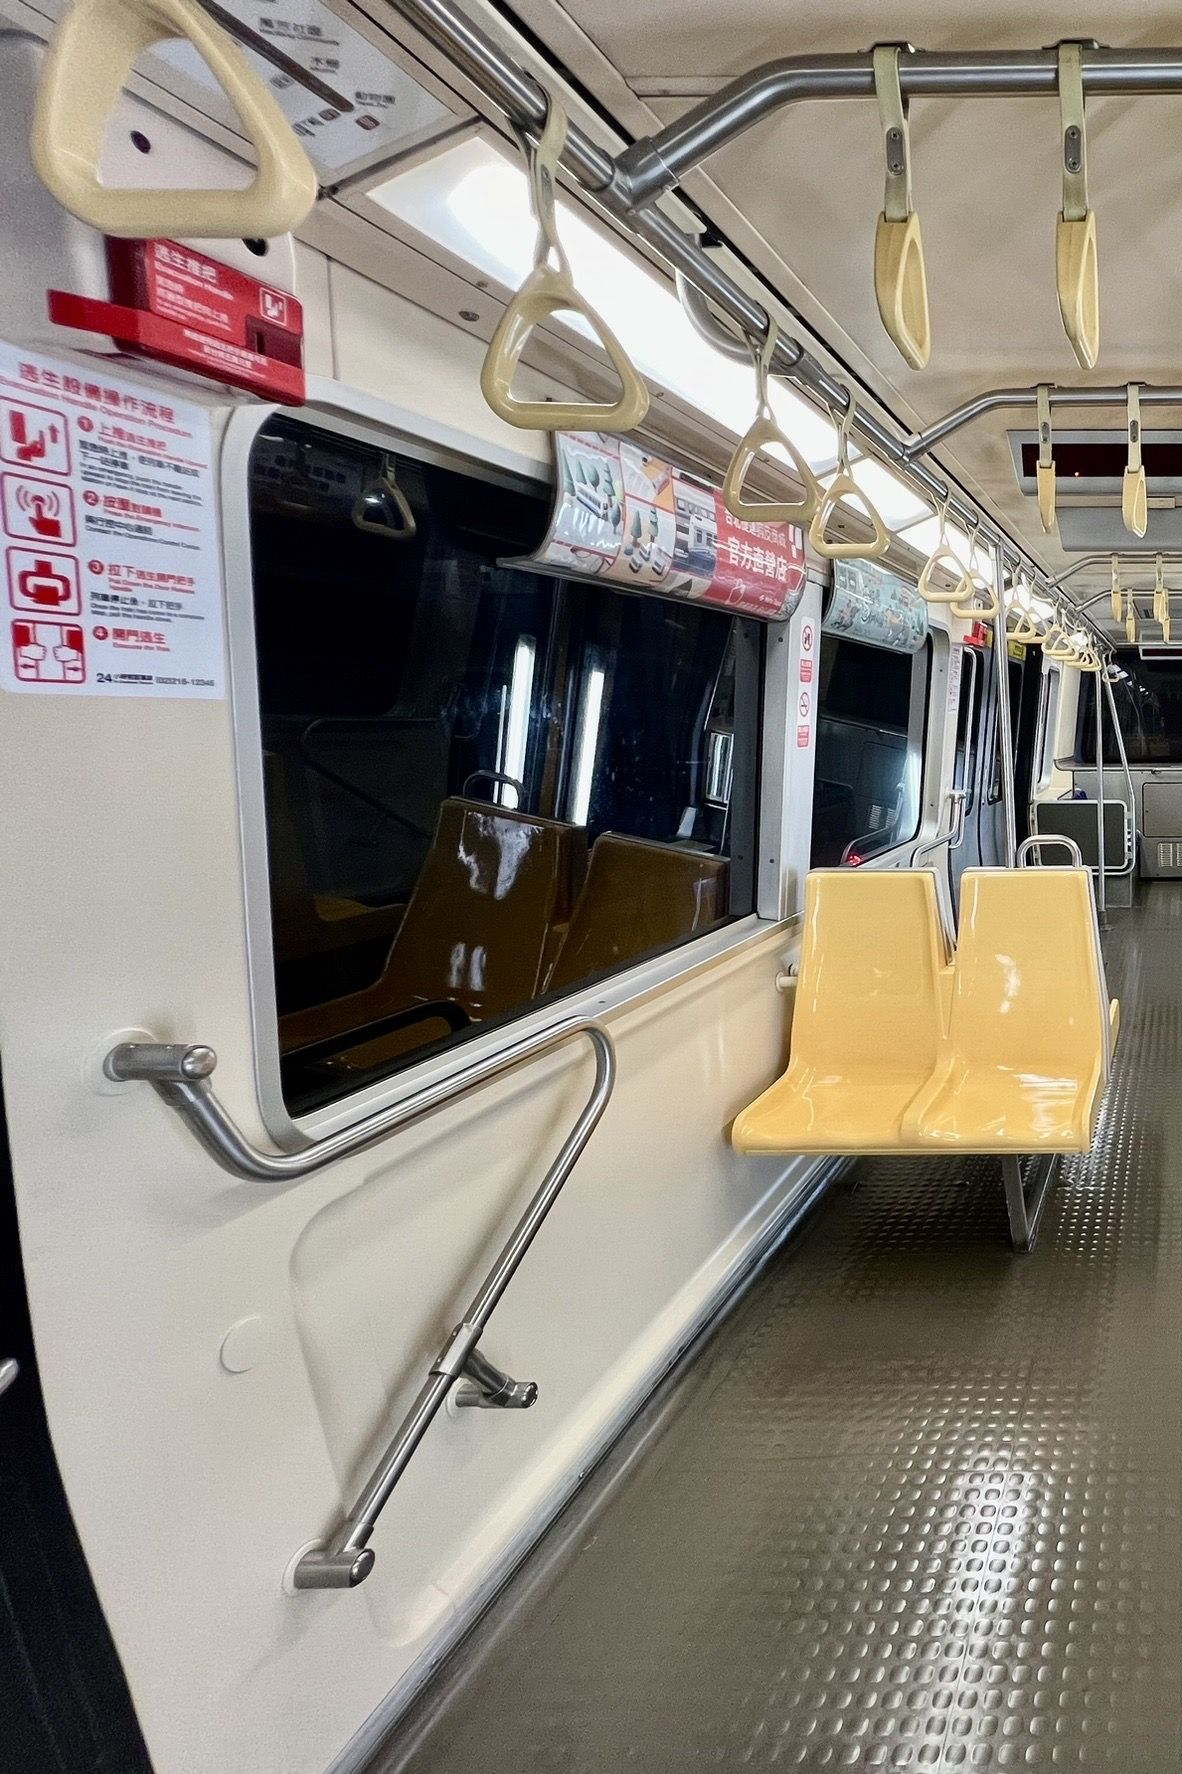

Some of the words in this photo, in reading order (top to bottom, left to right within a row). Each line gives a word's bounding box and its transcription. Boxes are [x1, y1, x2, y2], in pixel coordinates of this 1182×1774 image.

[18, 361, 174, 424] 逃生設備操作流程
[96, 673, 112, 683] 24
